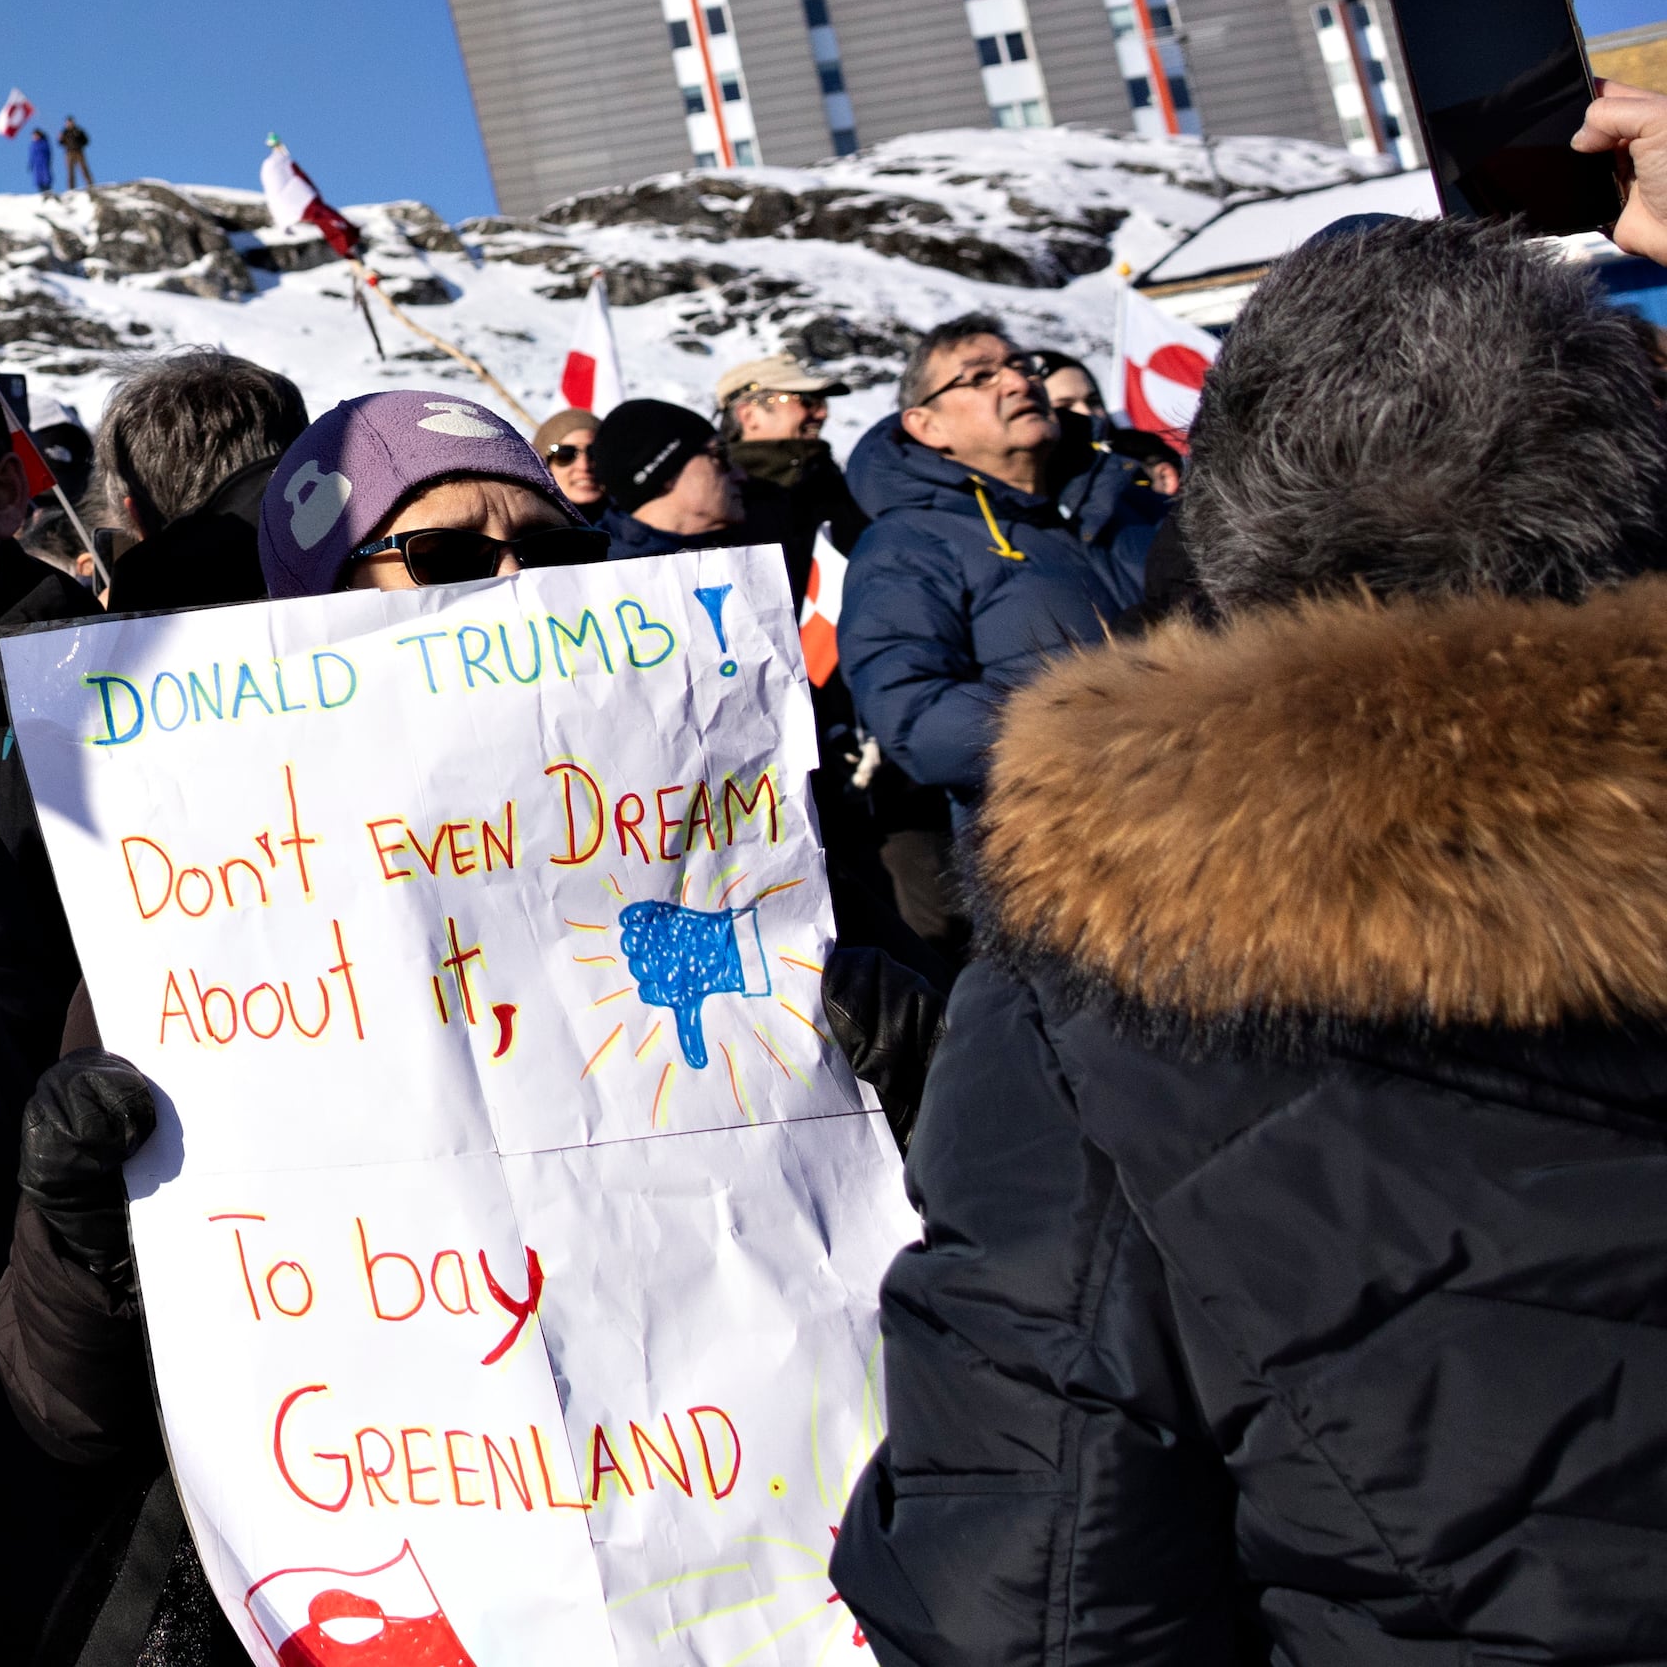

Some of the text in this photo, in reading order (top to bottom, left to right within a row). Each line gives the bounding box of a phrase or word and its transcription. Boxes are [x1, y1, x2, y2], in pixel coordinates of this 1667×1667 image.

[84, 651, 357, 748] DONALD
[121, 762, 779, 922] Don't EVEN DREAM
[158, 919, 366, 1045] About
[208, 1213, 546, 1367] To bay
[272, 1383, 785, 1513] GREENLAND.
